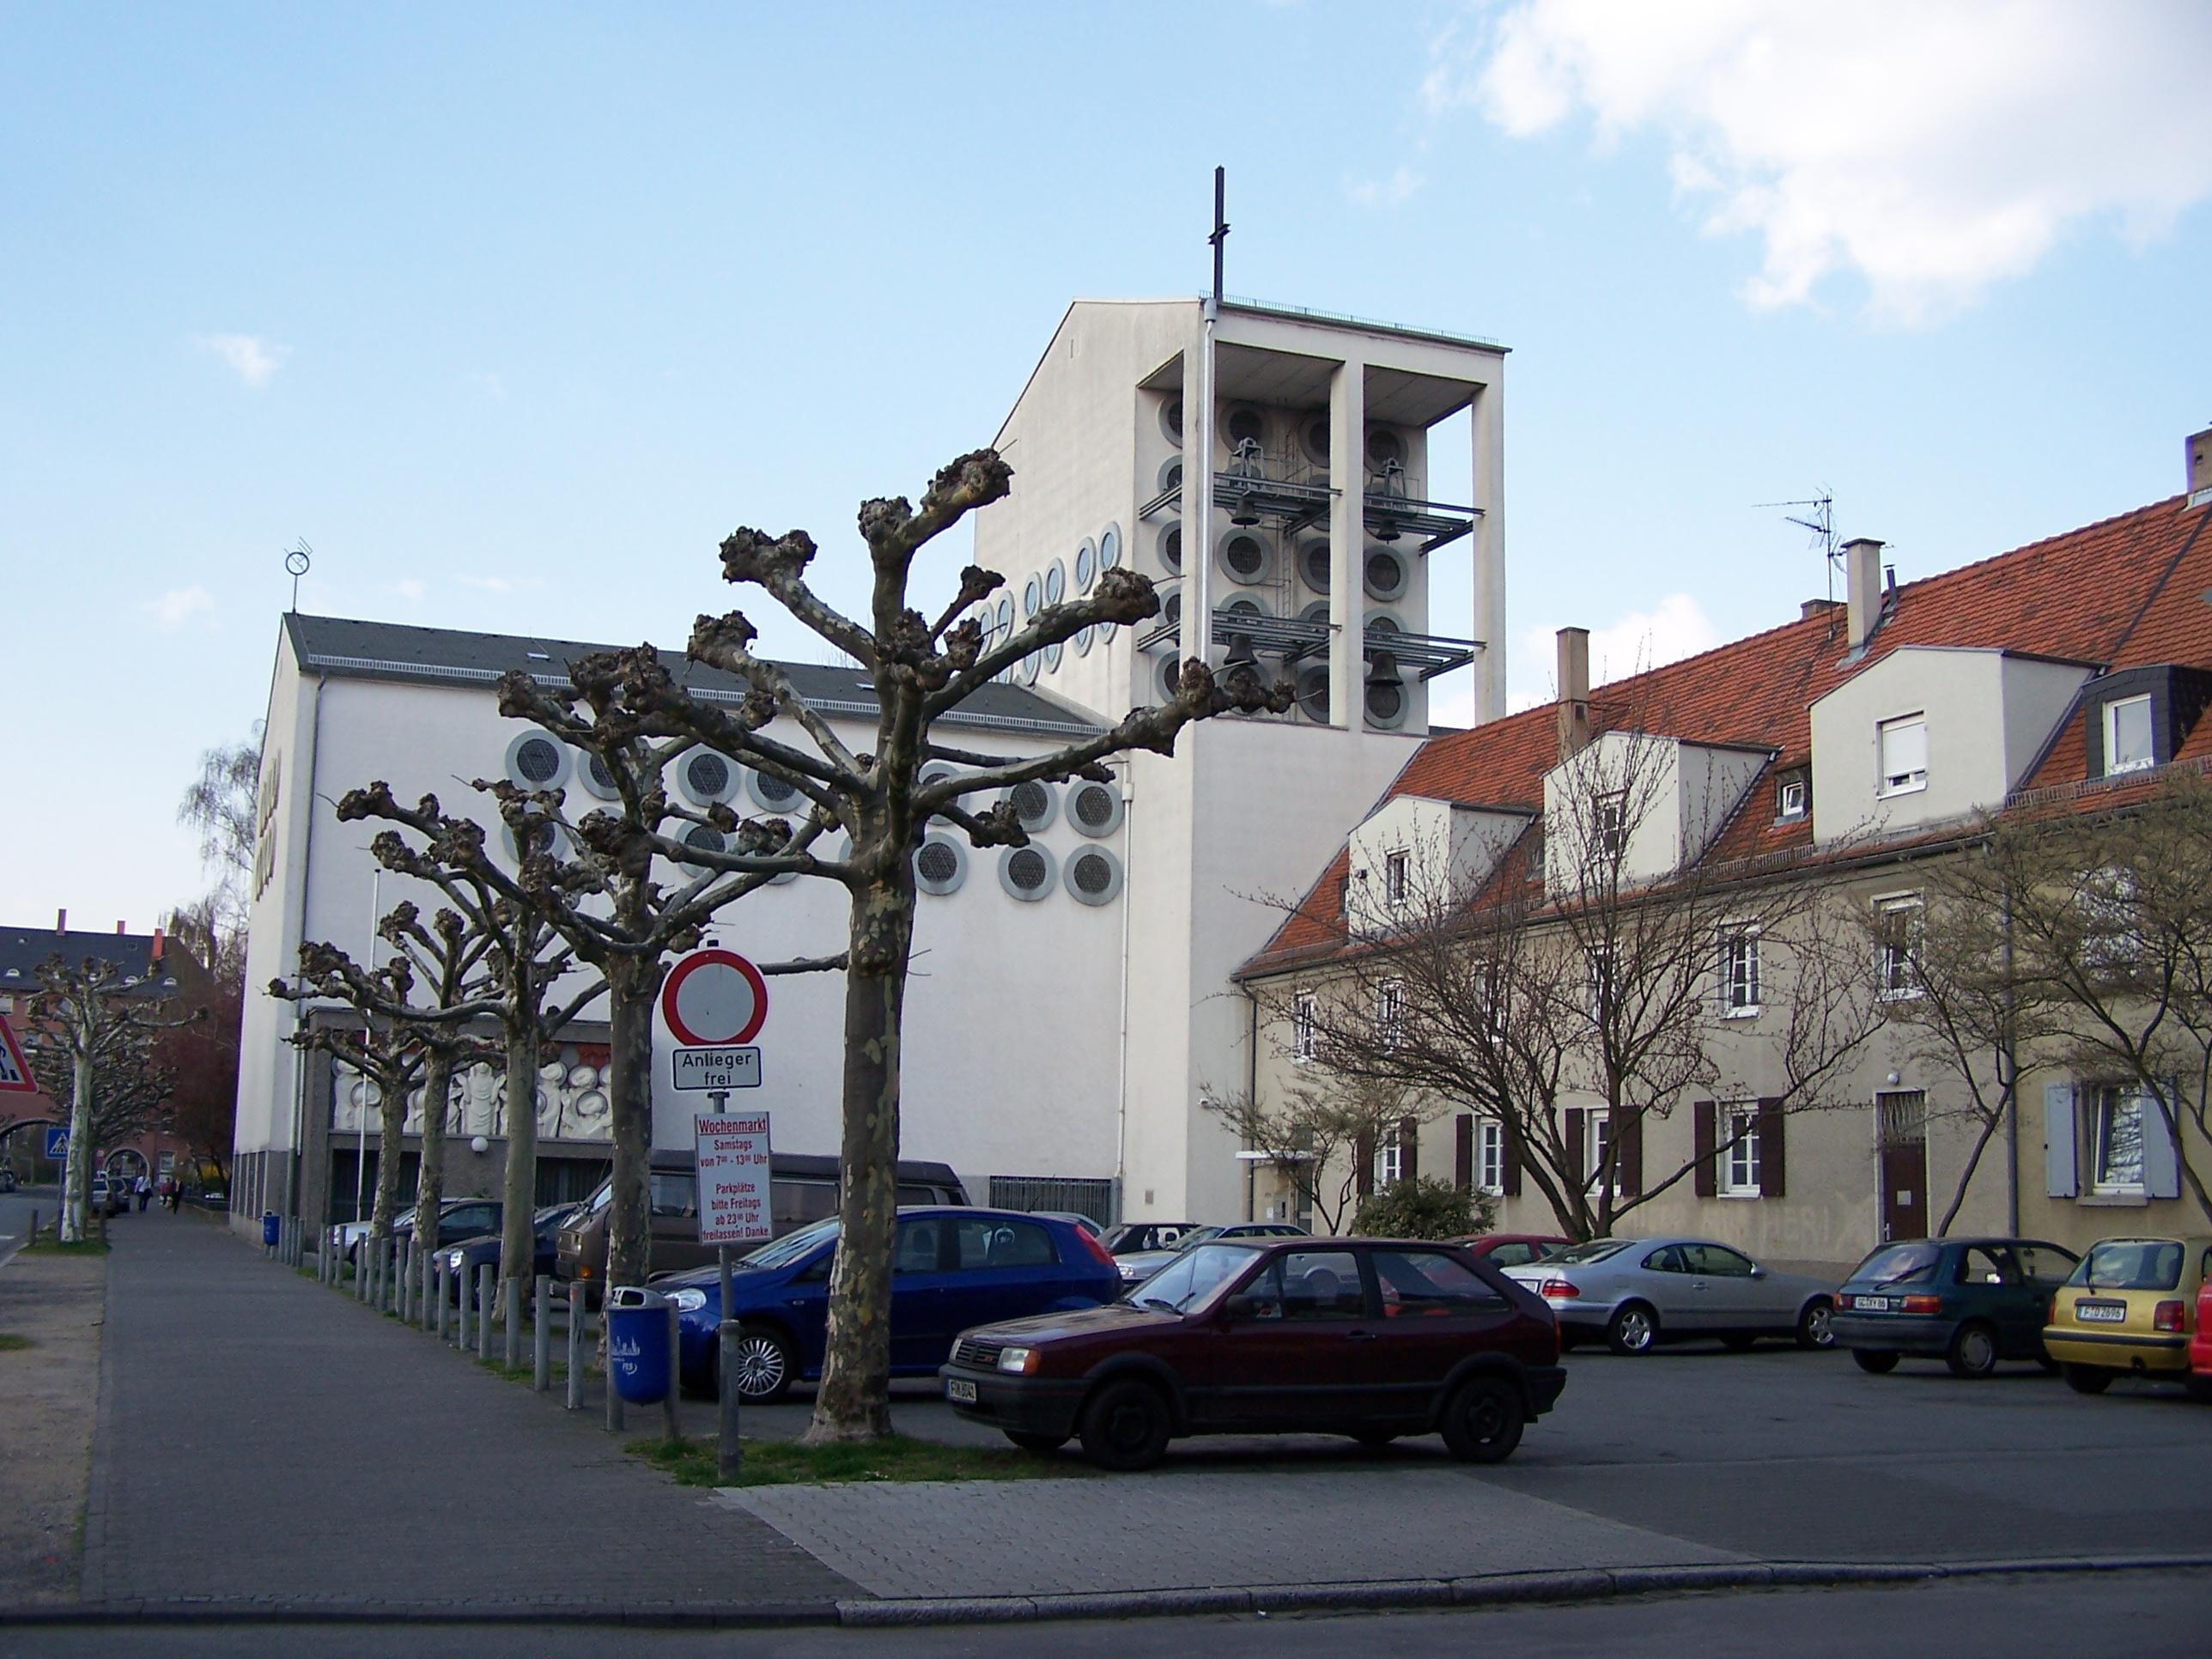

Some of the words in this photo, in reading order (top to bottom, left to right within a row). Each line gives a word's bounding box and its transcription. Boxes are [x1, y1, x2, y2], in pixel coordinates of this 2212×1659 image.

[682, 1053, 752, 1069] Anlieger
[705, 1071, 731, 1085] frei
[699, 1118, 766, 1133] Wochenmarkt
[714, 1139, 753, 1152] Samstags
[701, 1158, 714, 1167] von
[753, 1154, 768, 1164] Uhr
[715, 1182, 756, 1194] Parkplätze
[711, 1200, 729, 1210] bitte
[730, 1198, 762, 1209] Freitags
[715, 1214, 725, 1225] ab
[745, 1212, 760, 1224] Uhr
